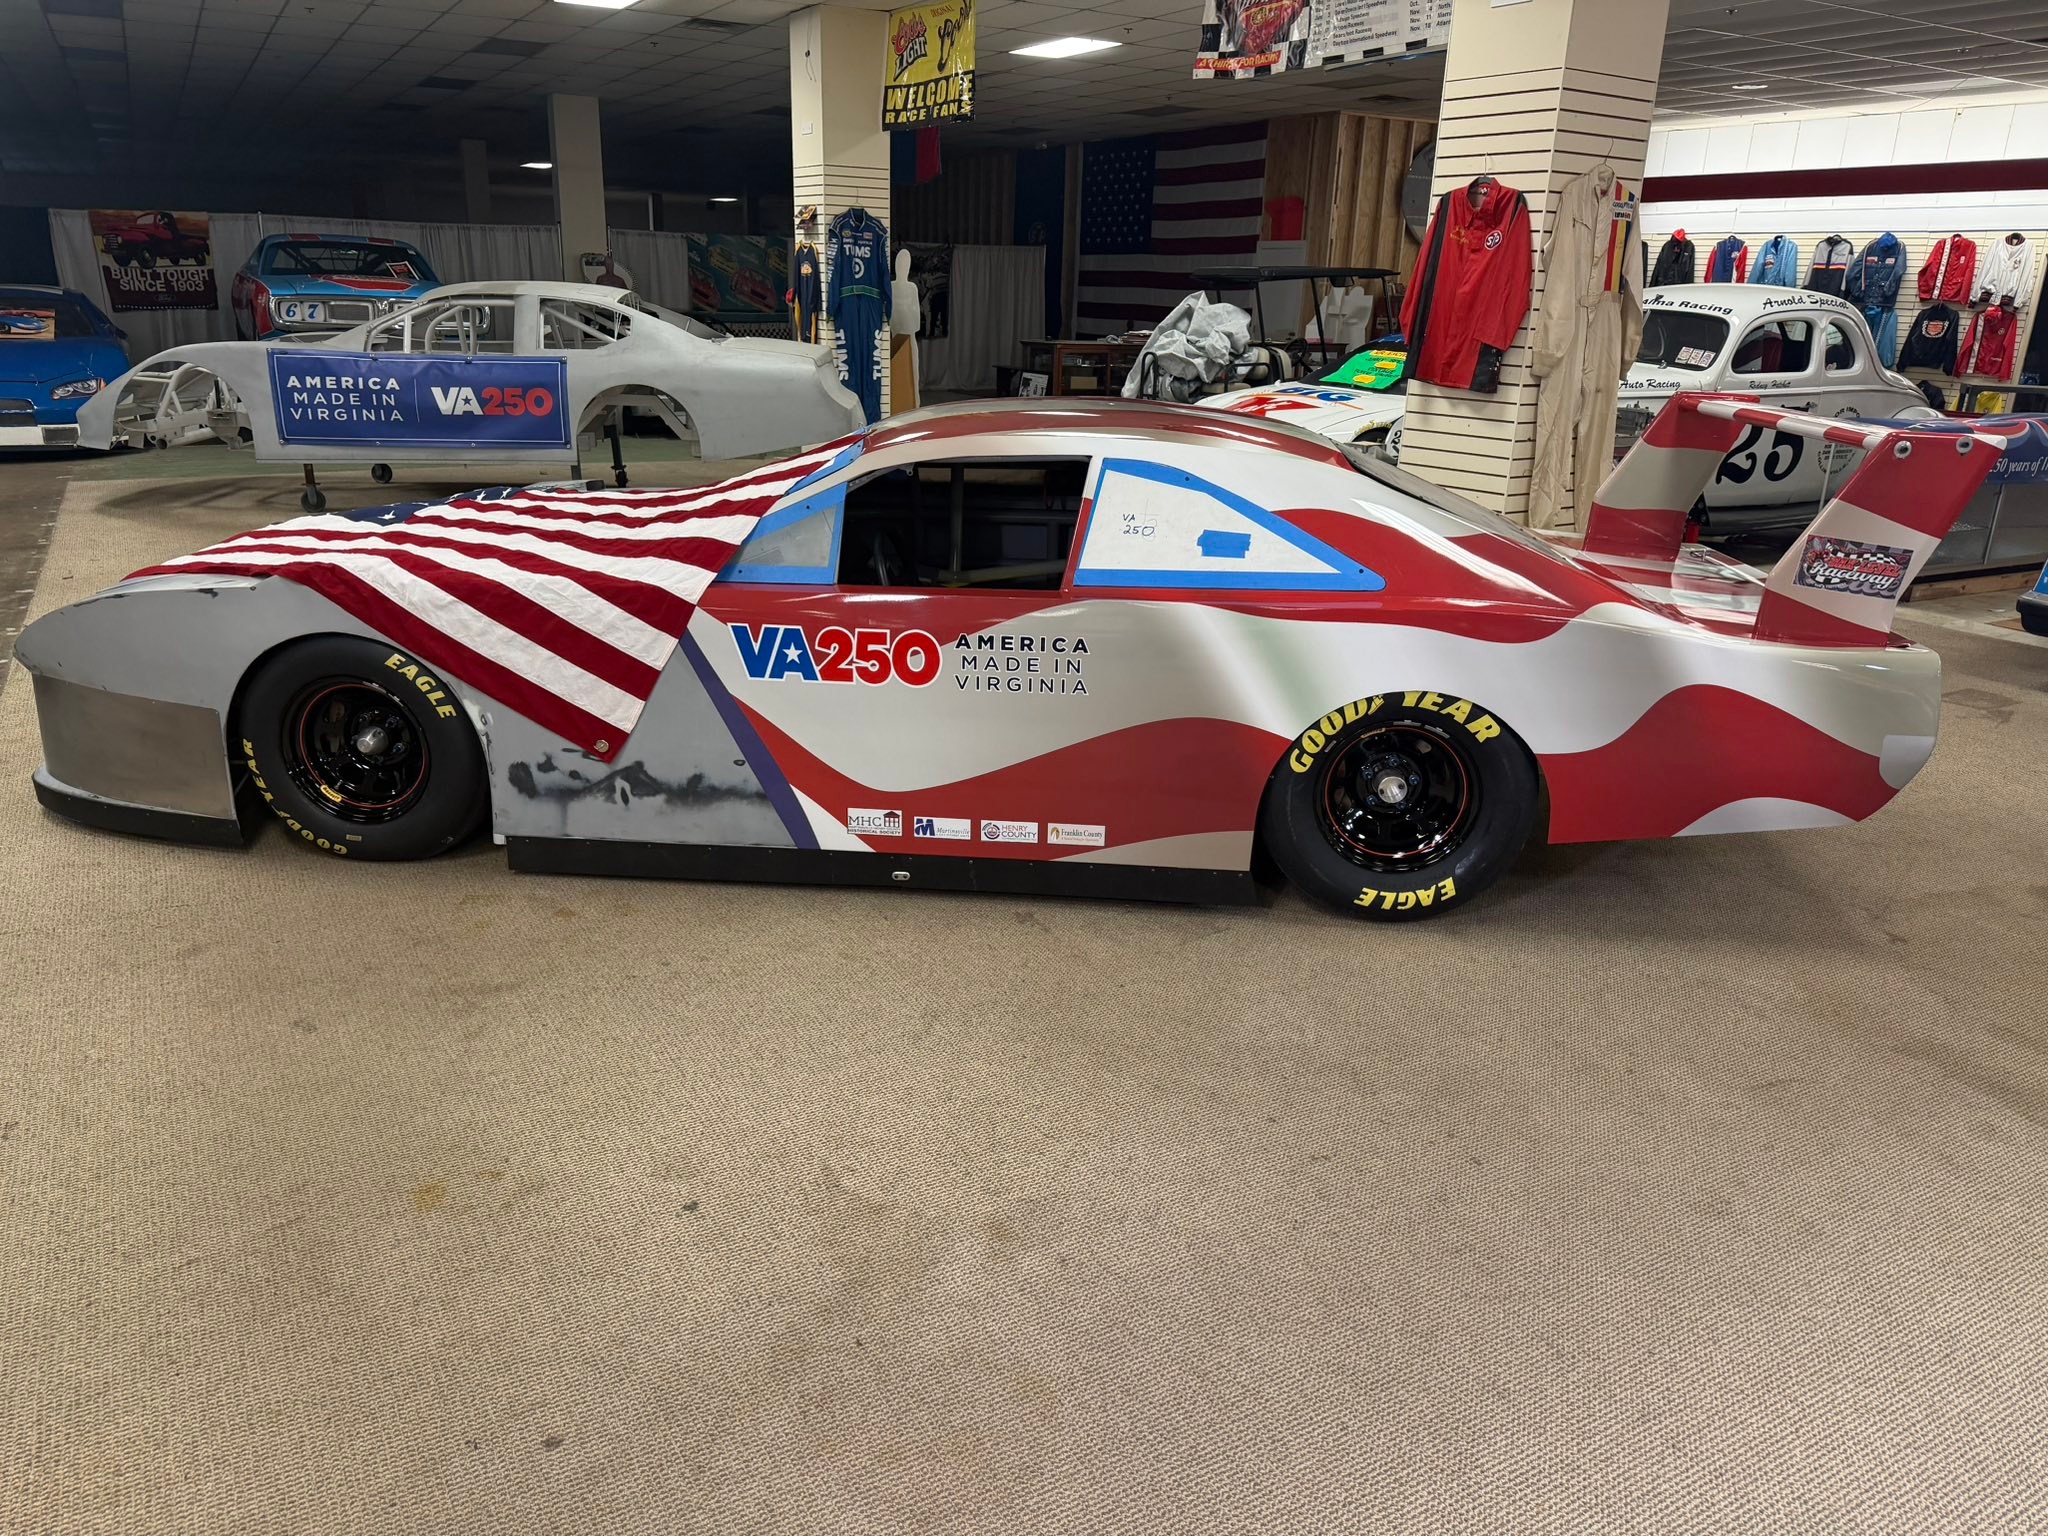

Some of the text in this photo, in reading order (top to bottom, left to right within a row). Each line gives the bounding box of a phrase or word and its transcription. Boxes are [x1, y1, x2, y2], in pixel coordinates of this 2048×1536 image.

[894, 36, 928, 81] LIGHT
[886, 74, 973, 110] WELCOME
[884, 100, 974, 124] RACE FANS
[1486, 232, 1500, 248] STP
[844, 244, 871, 258] TUMS
[111, 266, 209, 282] BUILT TOUGH
[120, 280, 204, 292] SINCE 1903
[1678, 300, 1734, 315] Racing
[1762, 294, 1850, 310] Arnold Special
[286, 376, 400, 390] AMERICA
[1618, 379, 1681, 390] Auto Racing
[294, 392, 395, 406] MADE IN
[430, 386, 554, 416] VA250
[290, 408, 404, 422] VIRGINIA
[1715, 424, 1804, 485] 25
[1990, 458, 2008, 473] 50
[2005, 461, 2030, 478] years
[2030, 456, 2042, 477] of
[1122, 514, 1136, 522] VA
[1123, 525, 1155, 536] 250
[1810, 562, 1896, 590] Raceway
[954, 633, 1090, 654] AMERICA
[727, 622, 942, 688] VA250
[962, 655, 1082, 674] MADE IN
[384, 653, 457, 719] EAGLE
[954, 675, 1088, 695] VIRGINIA
[848, 815, 881, 827] MHC
[1061, 828, 1082, 837] Franklin
[1083, 830, 1103, 839] County
[1353, 876, 1456, 910] EAGLE
